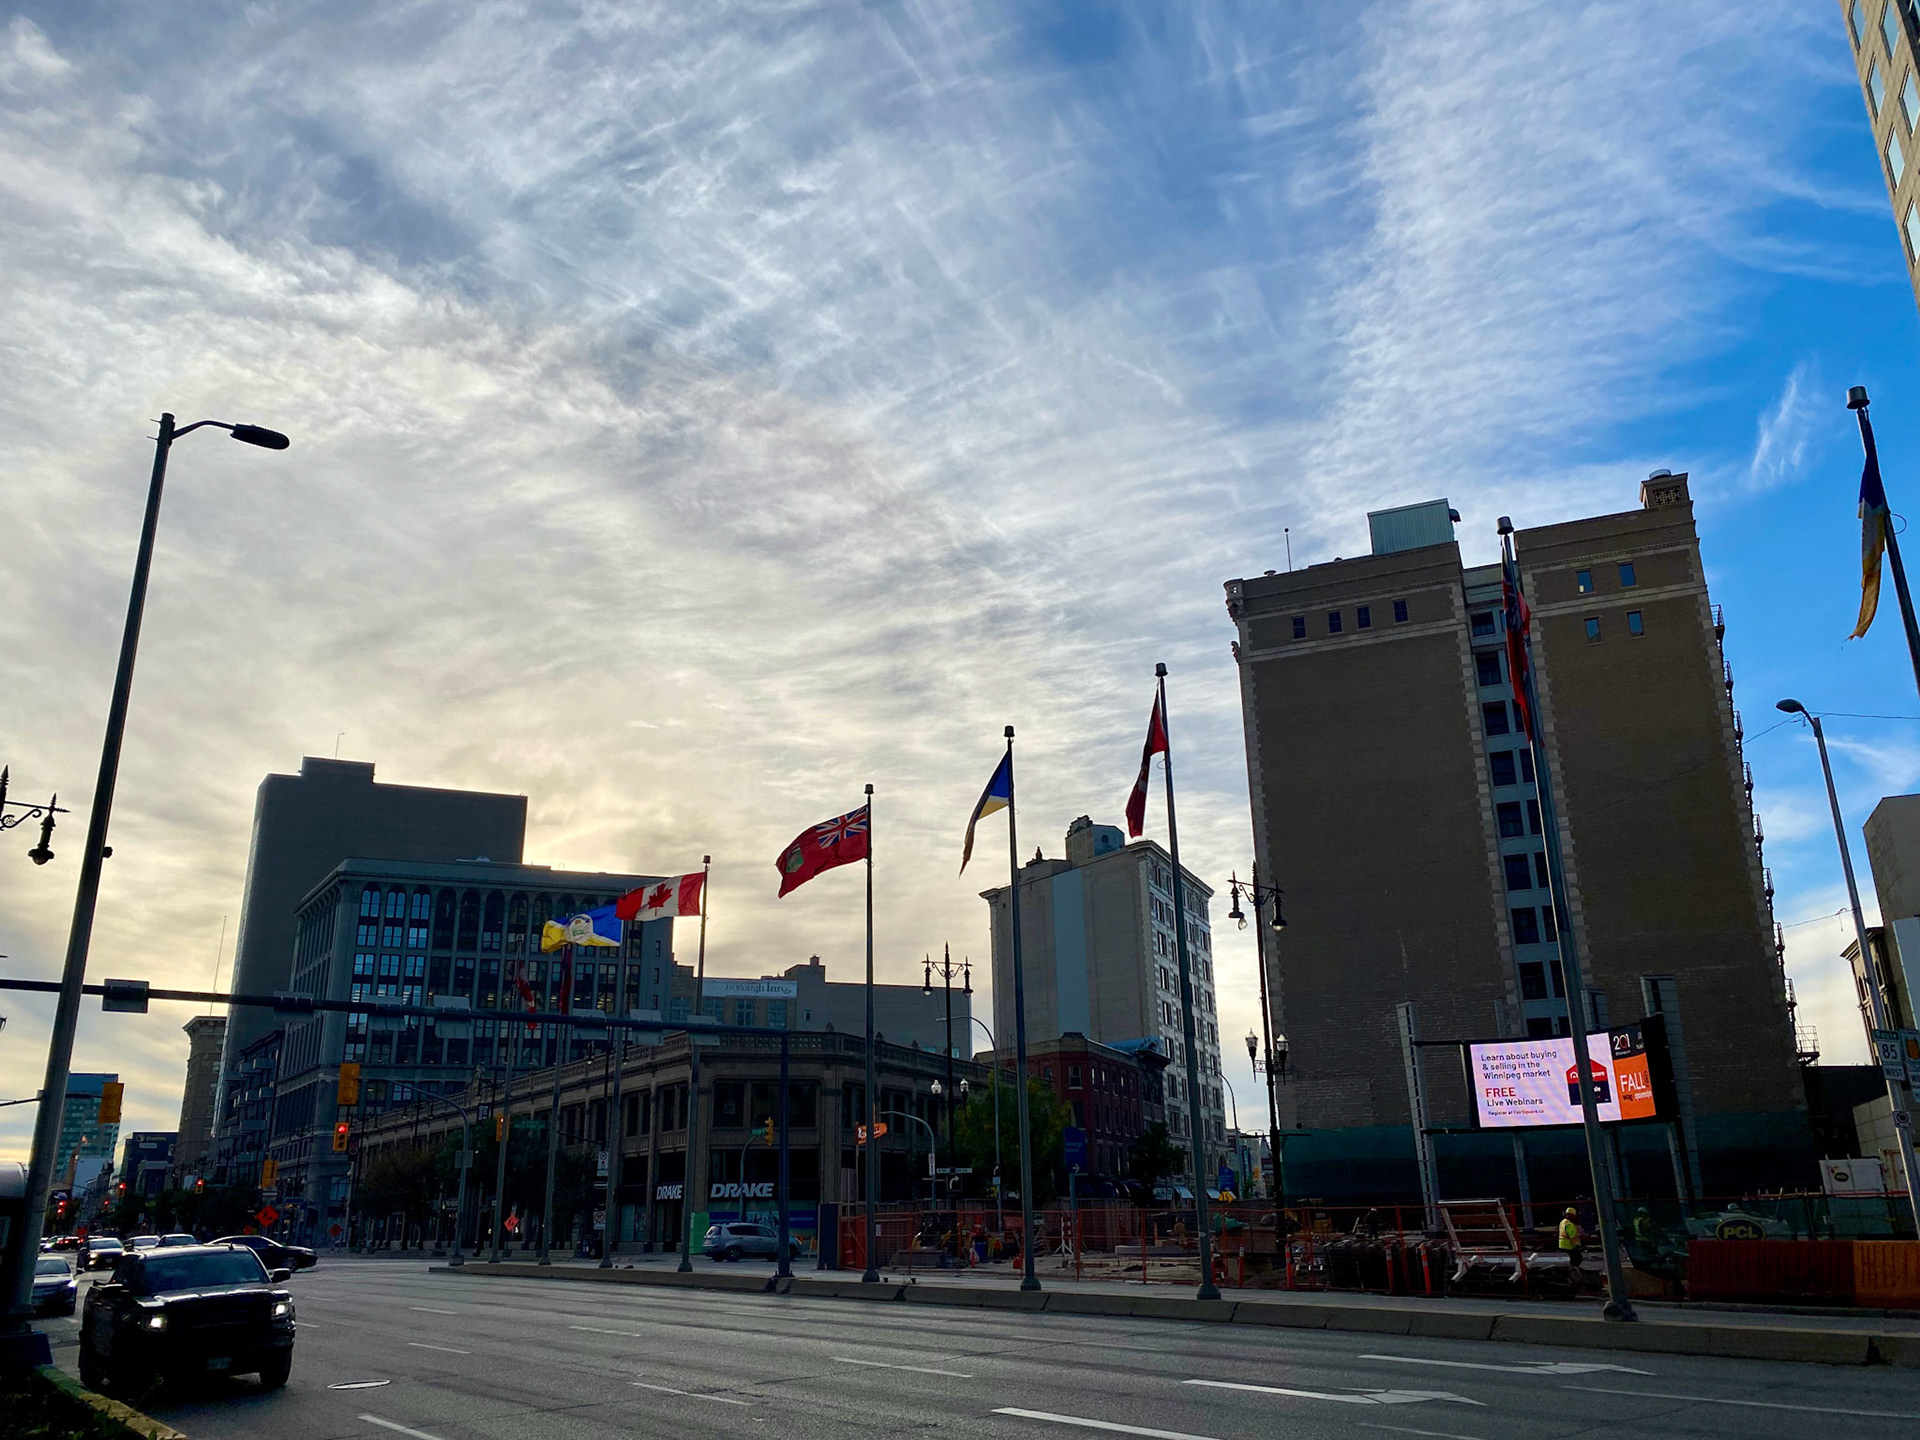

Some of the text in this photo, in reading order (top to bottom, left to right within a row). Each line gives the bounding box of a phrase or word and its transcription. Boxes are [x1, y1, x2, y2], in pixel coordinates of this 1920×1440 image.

[1506, 1052, 1529, 1060] about
[1530, 1050, 1557, 1060] buying
[1882, 1043, 1898, 1059] 85
[1490, 1062, 1517, 1071] selling
[1518, 1061, 1526, 1069] in
[1527, 1061, 1540, 1069] the
[1483, 1069, 1551, 1080] Winnipeg market
[1885, 1068, 1903, 1077] WEST
[1620, 1072, 1646, 1092] FALL
[1485, 1087, 1516, 1098] FREE
[1486, 1098, 1544, 1107] Live Webinars
[656, 1184, 683, 1200] DRAKE
[710, 1182, 775, 1198] DRAKE
[1723, 1225, 1759, 1240] PCL
